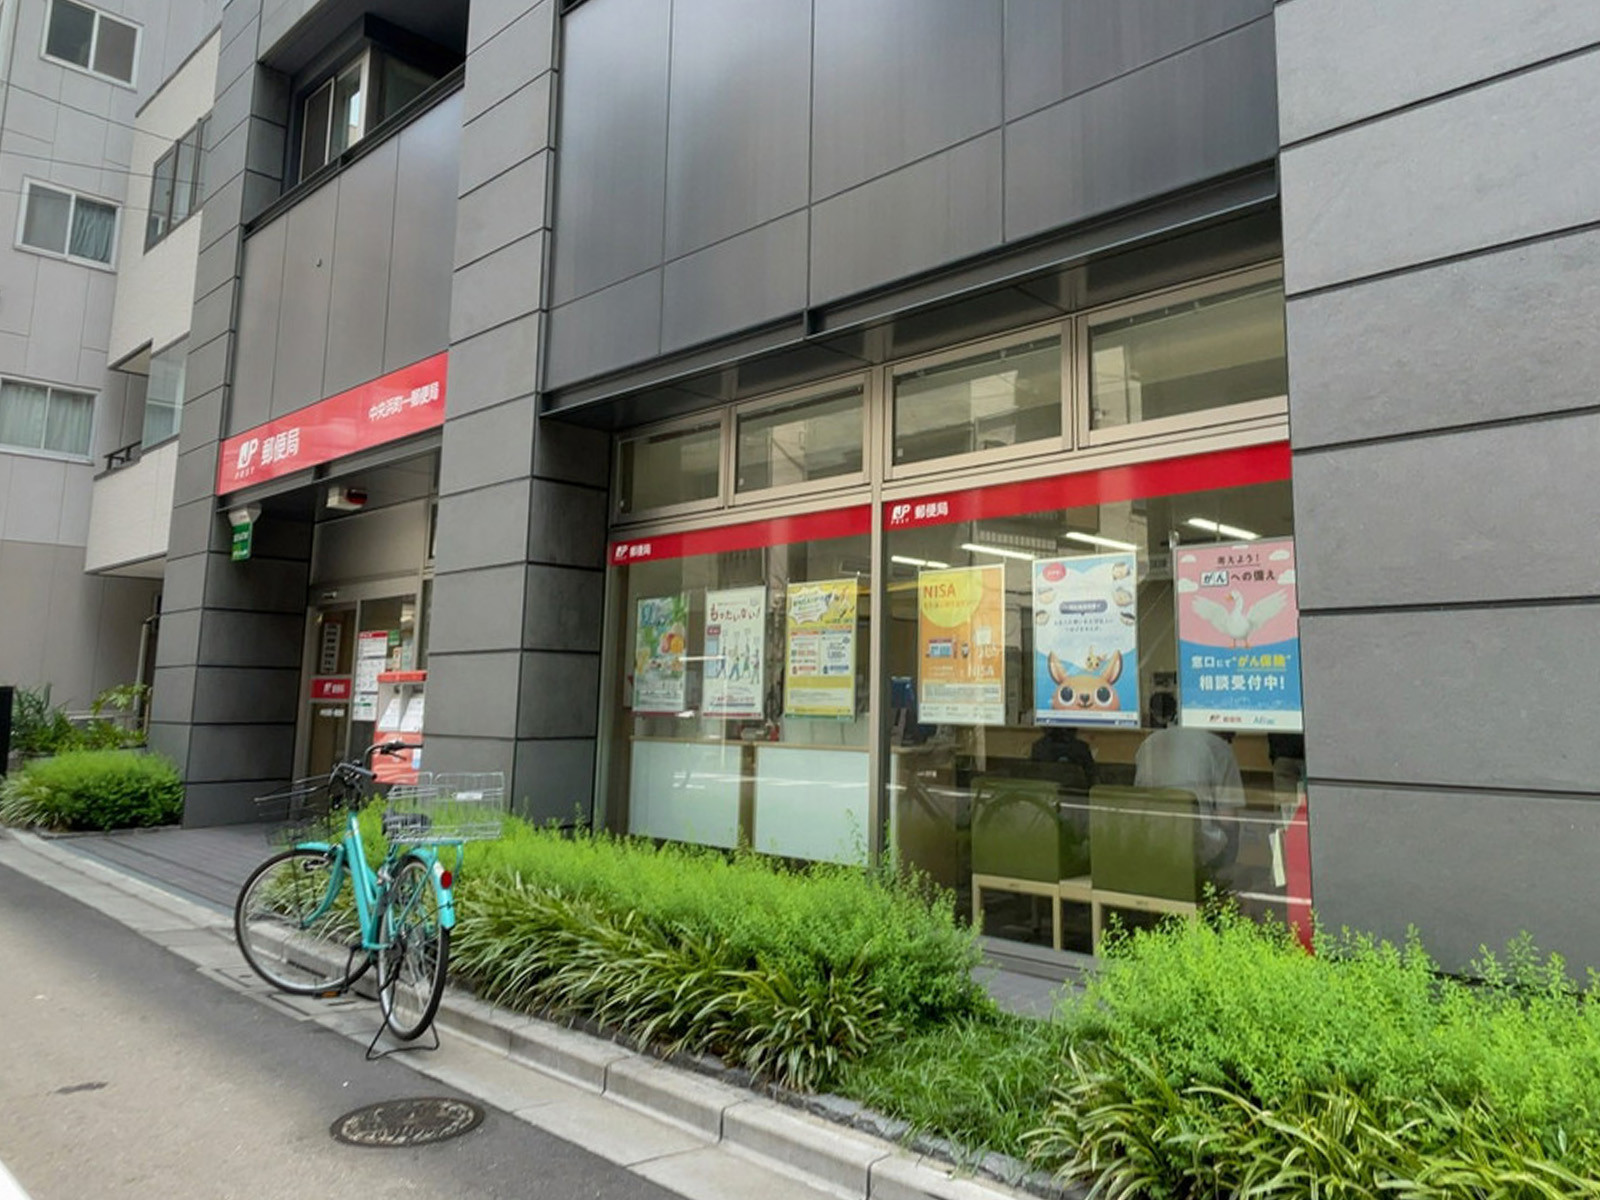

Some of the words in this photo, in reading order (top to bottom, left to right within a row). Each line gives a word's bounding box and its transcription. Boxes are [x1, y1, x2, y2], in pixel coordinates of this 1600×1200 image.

[261, 427, 300, 465] 郵便局
[914, 501, 949, 519] 郵便局
[923, 583, 956, 599] NISA
[1199, 673, 1285, 692] 相談受付中!
